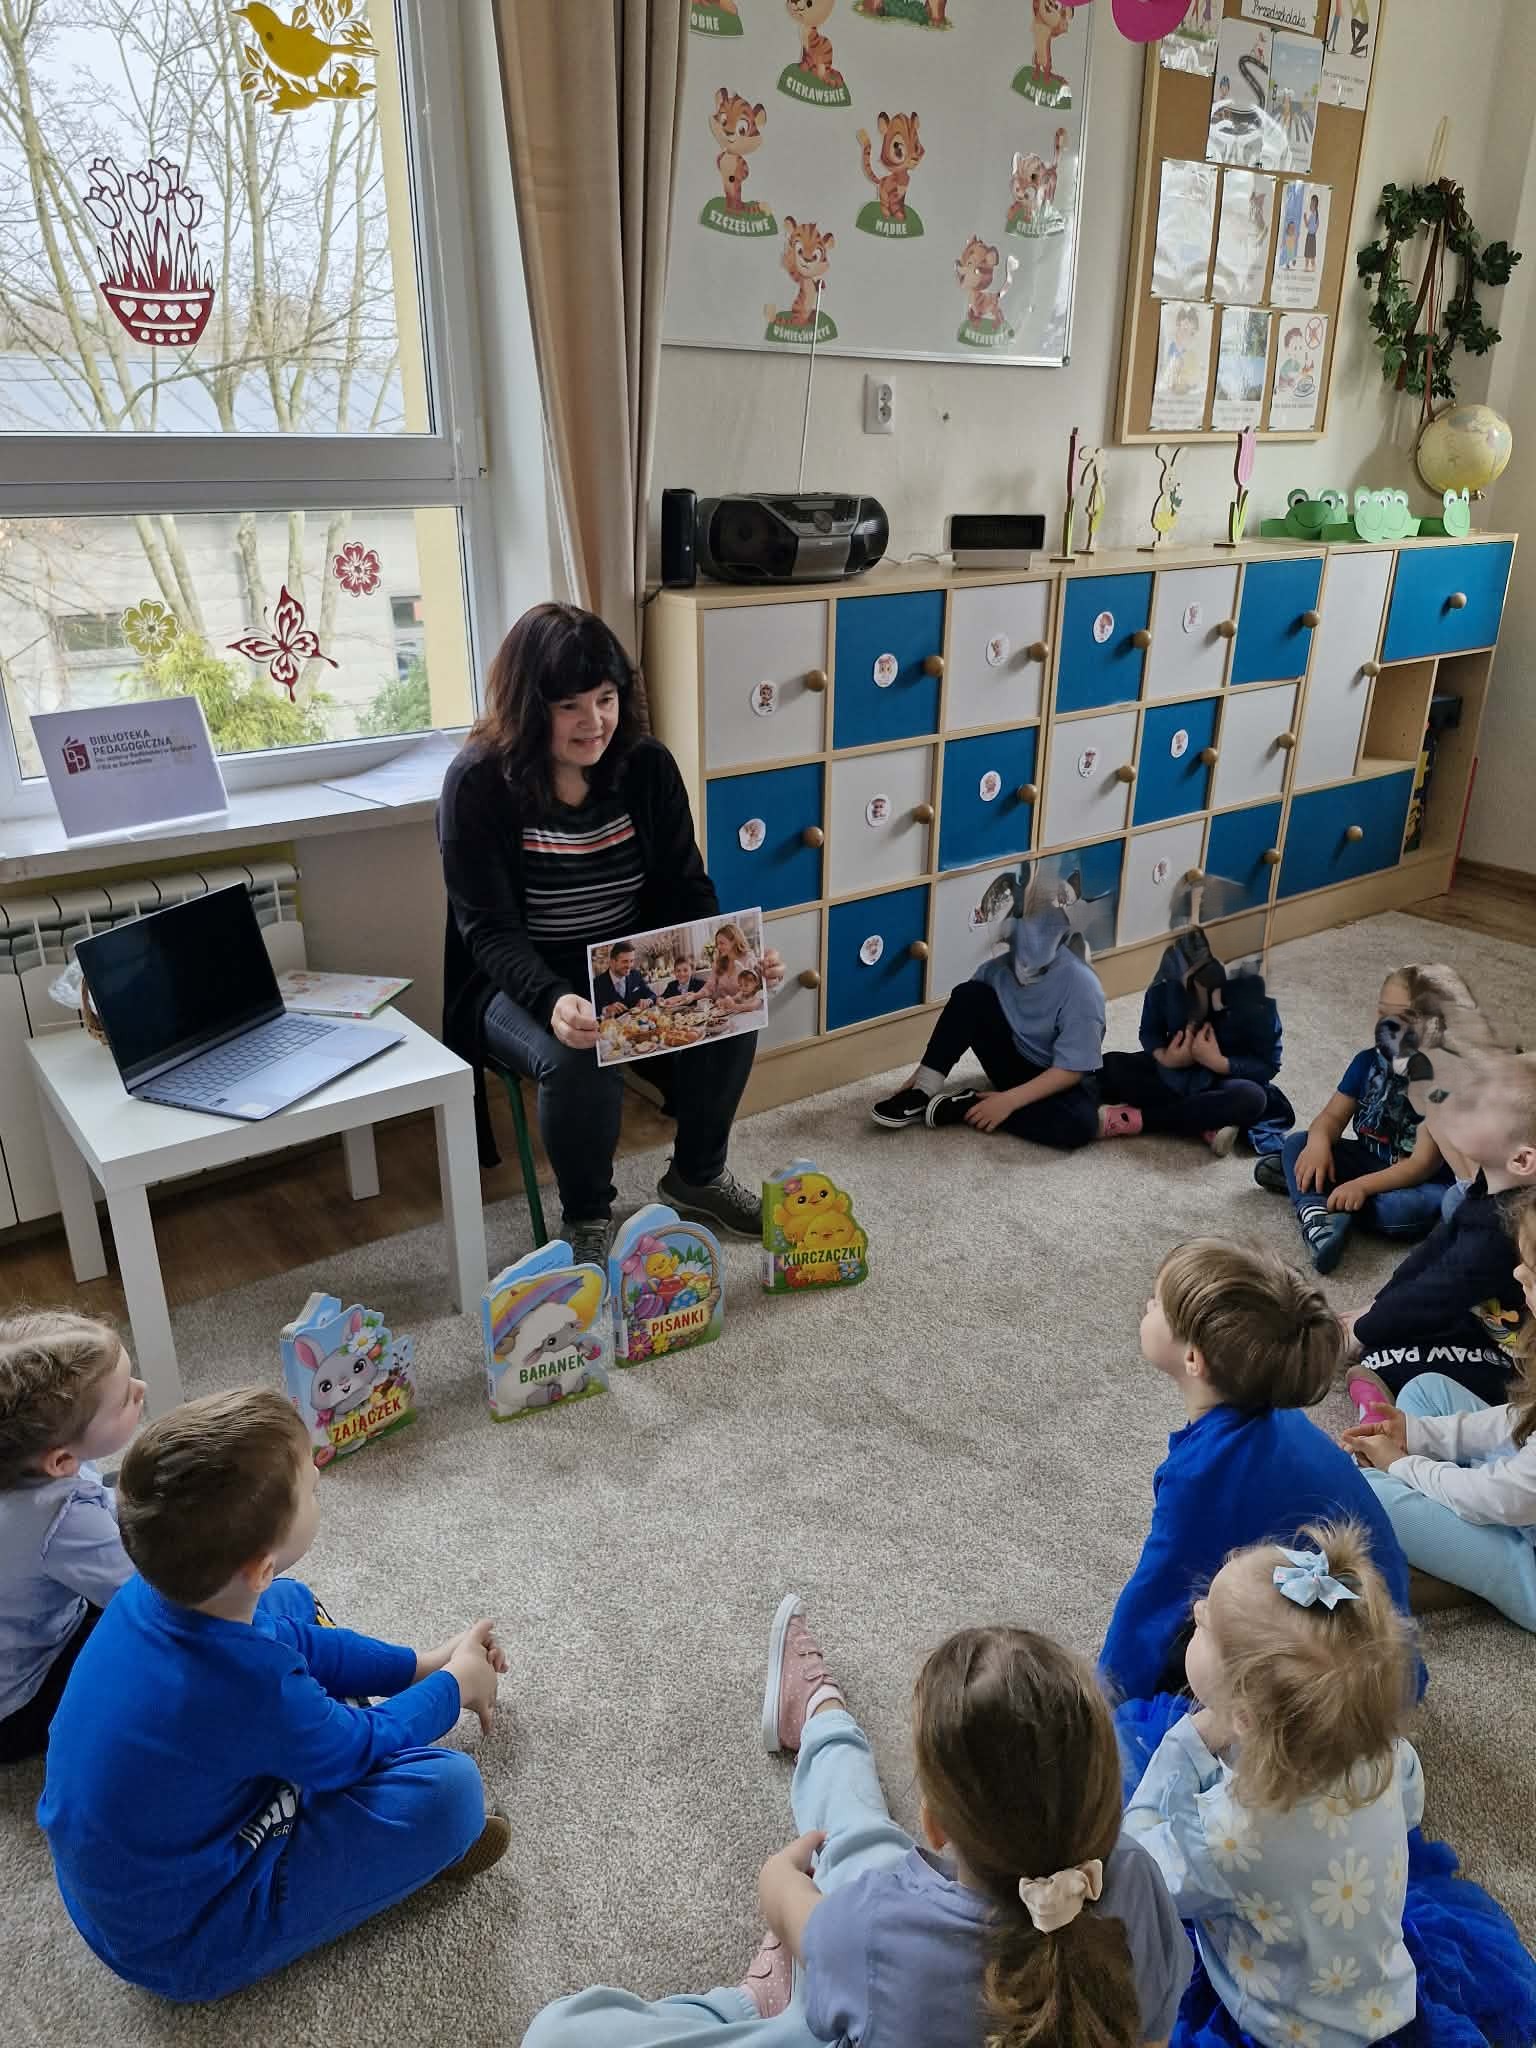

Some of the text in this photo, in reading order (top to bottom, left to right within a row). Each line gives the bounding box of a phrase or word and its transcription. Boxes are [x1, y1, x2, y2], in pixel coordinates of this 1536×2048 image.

[786, 76, 846, 104] CIEKAWSKIE
[89, 729, 151, 746] BIBLIOTEKA
[92, 736, 173, 756] PEDAGOGICZNA
[783, 1246, 861, 1268] KURCZACZKI
[651, 1308, 704, 1337] PISANKI
[1426, 1346, 1483, 1363] PAW
[519, 1352, 586, 1384] BARANEK
[332, 1396, 402, 1443] ZAJĄCZEK
